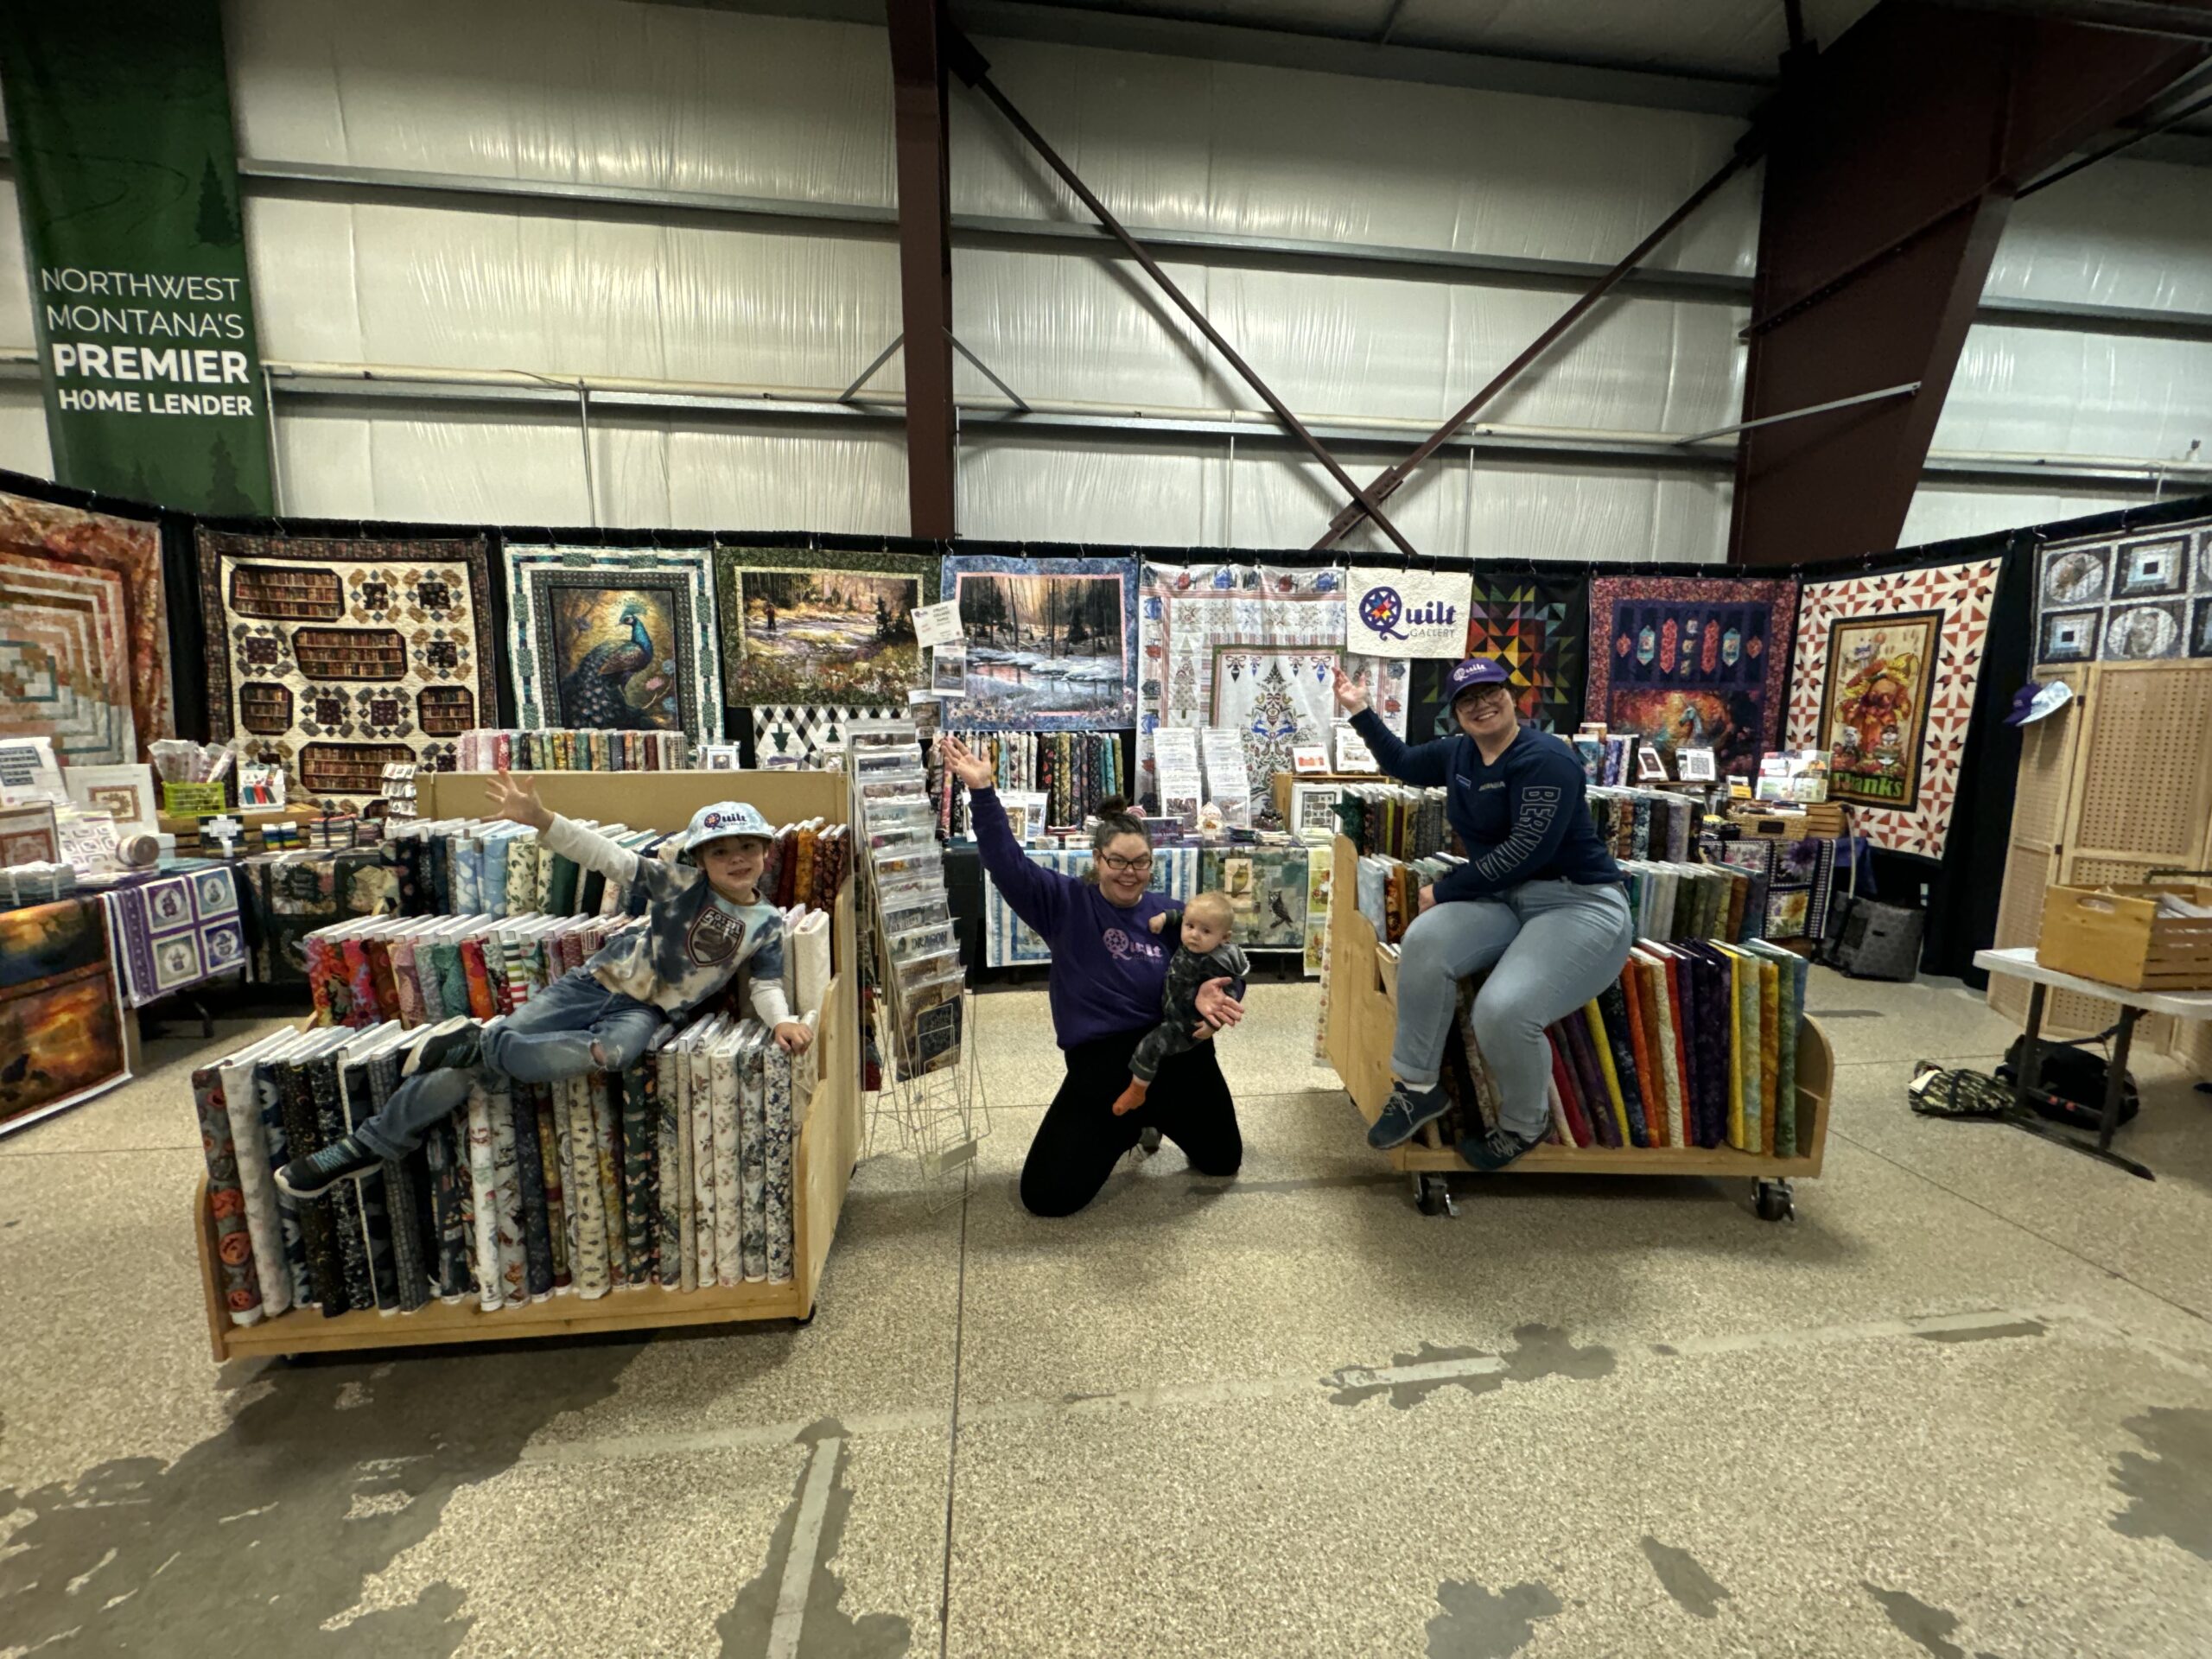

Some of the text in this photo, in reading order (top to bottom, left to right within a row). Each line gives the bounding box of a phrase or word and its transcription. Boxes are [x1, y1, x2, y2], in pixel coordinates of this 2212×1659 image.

[41, 268, 240, 302] NORTHWEST
[47, 304, 245, 339] MONTANA'S
[52, 343, 250, 384] PREMIER
[59, 389, 254, 416] HOME LENDER
[1359, 586, 1457, 641] Quilt
[1409, 628, 1456, 638] GALLERY
[1453, 663, 1487, 682] Quilt
[1834, 772, 1903, 798] Thanks
[1475, 785, 1561, 881] BERNINA
